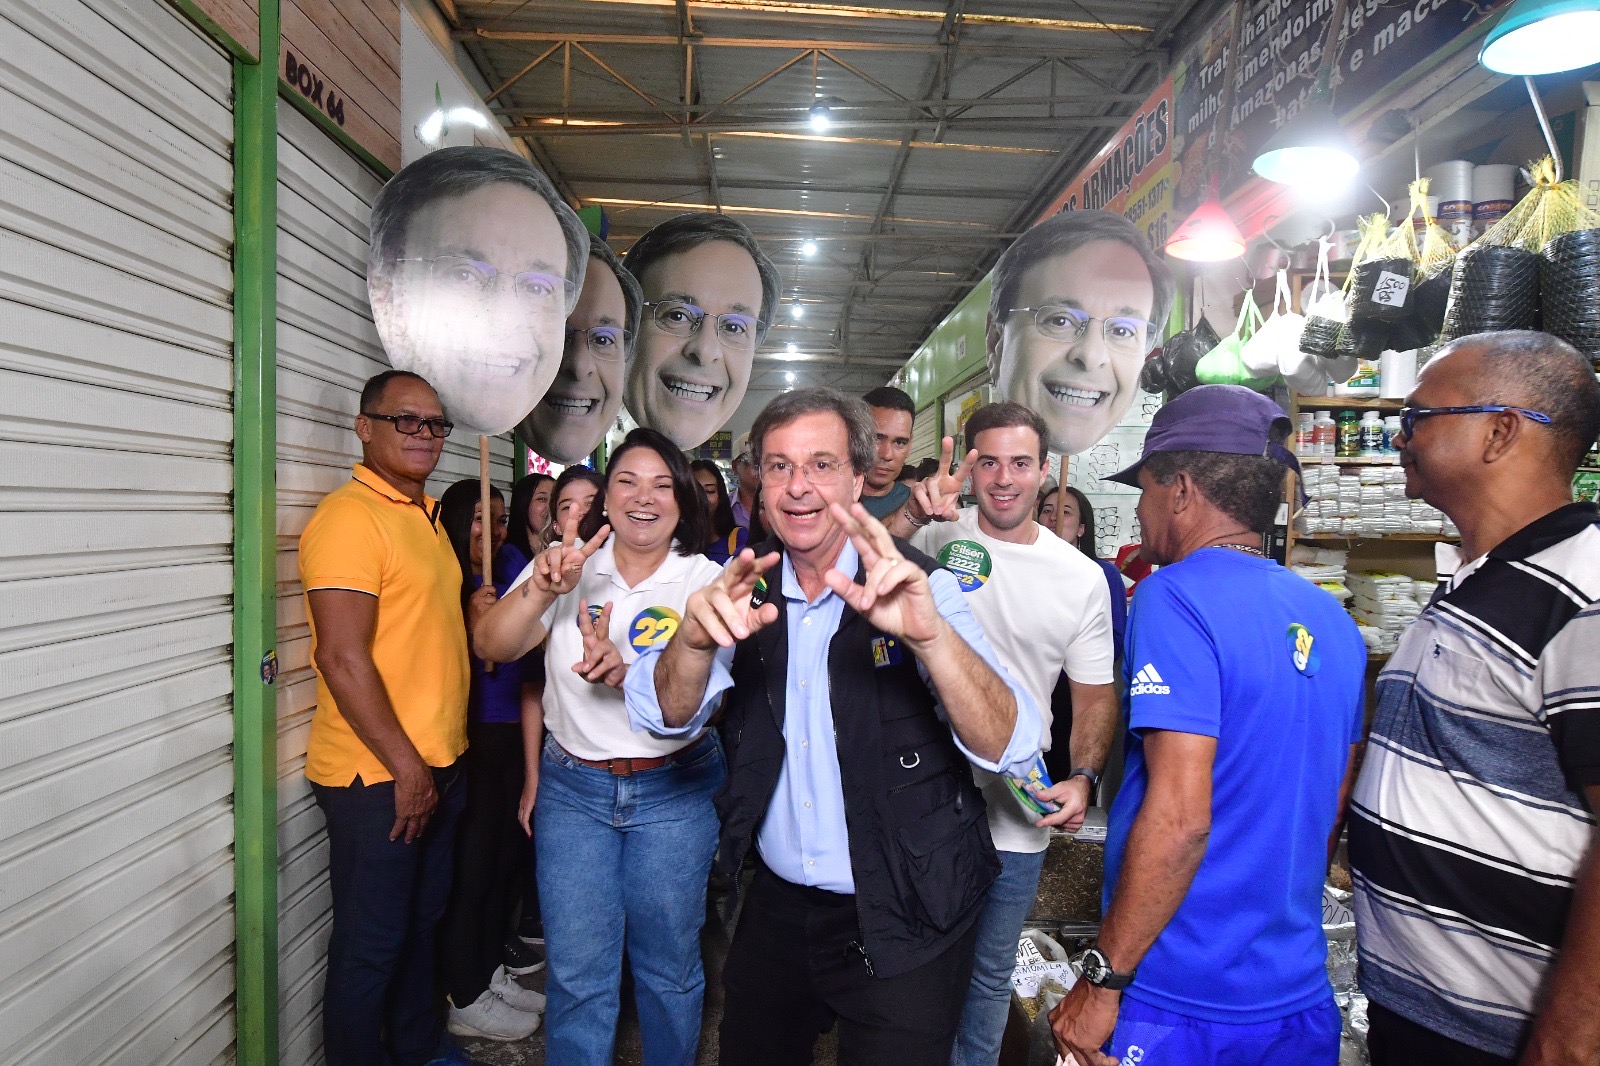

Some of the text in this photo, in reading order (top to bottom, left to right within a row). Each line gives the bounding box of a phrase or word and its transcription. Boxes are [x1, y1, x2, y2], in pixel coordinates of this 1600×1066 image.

[1350, 48, 1364, 72] e
[285, 49, 323, 109] BOX
[1083, 98, 1169, 210] ARMAÇÕES
[950, 543, 985, 559] Gilson
[946, 556, 981, 571] 22222
[632, 616, 679, 647] 22
[1130, 682, 1171, 697] adidas
